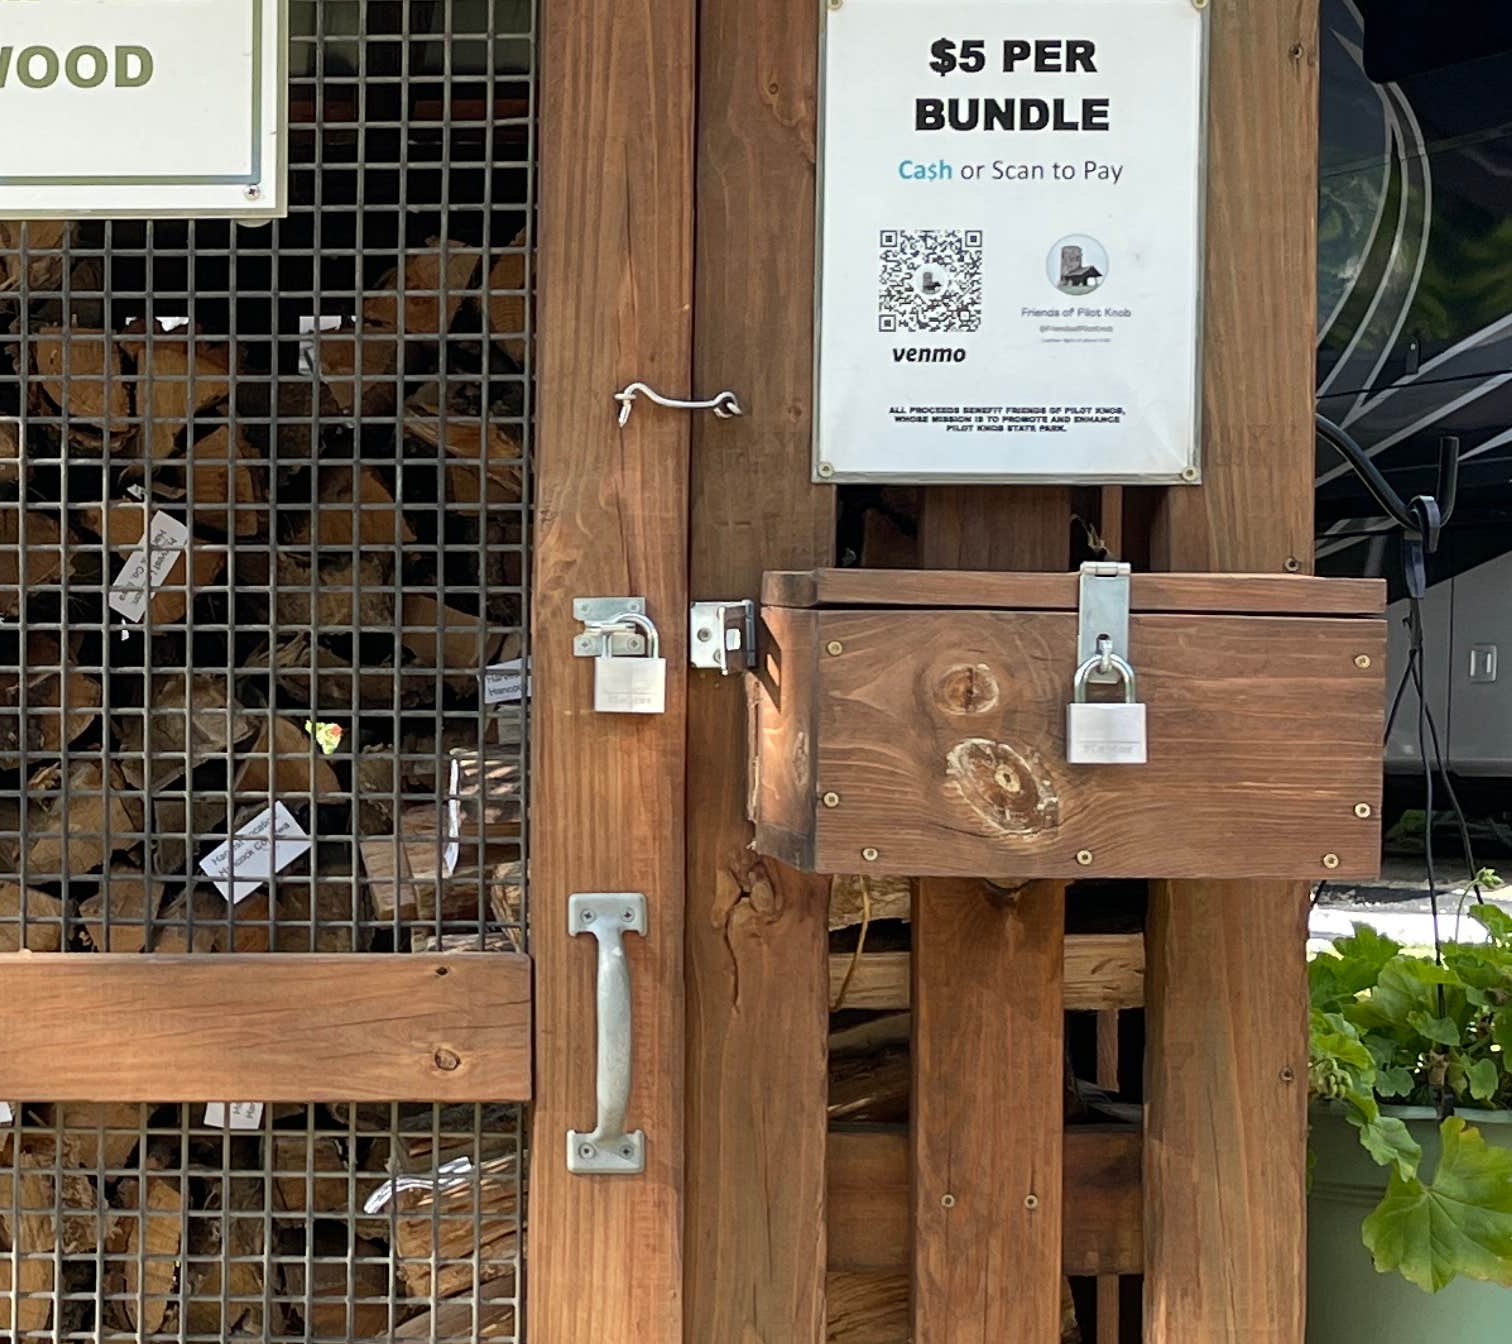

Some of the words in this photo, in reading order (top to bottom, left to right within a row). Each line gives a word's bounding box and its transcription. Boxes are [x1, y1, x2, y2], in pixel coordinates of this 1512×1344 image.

[929, 37, 986, 76] $5
[1002, 40, 1098, 73] PER
[914, 98, 1110, 131] BUNDLE
[960, 164, 985, 180] or
[991, 160, 1044, 180] Scan
[1053, 162, 1076, 180] to
[1084, 160, 1124, 184] Pay
[1021, 307, 1060, 317] Friends
[1062, 307, 1074, 317] of
[1077, 307, 1101, 317] Pilot
[1104, 307, 1132, 317] Knob
[892, 347, 966, 362] venmo
